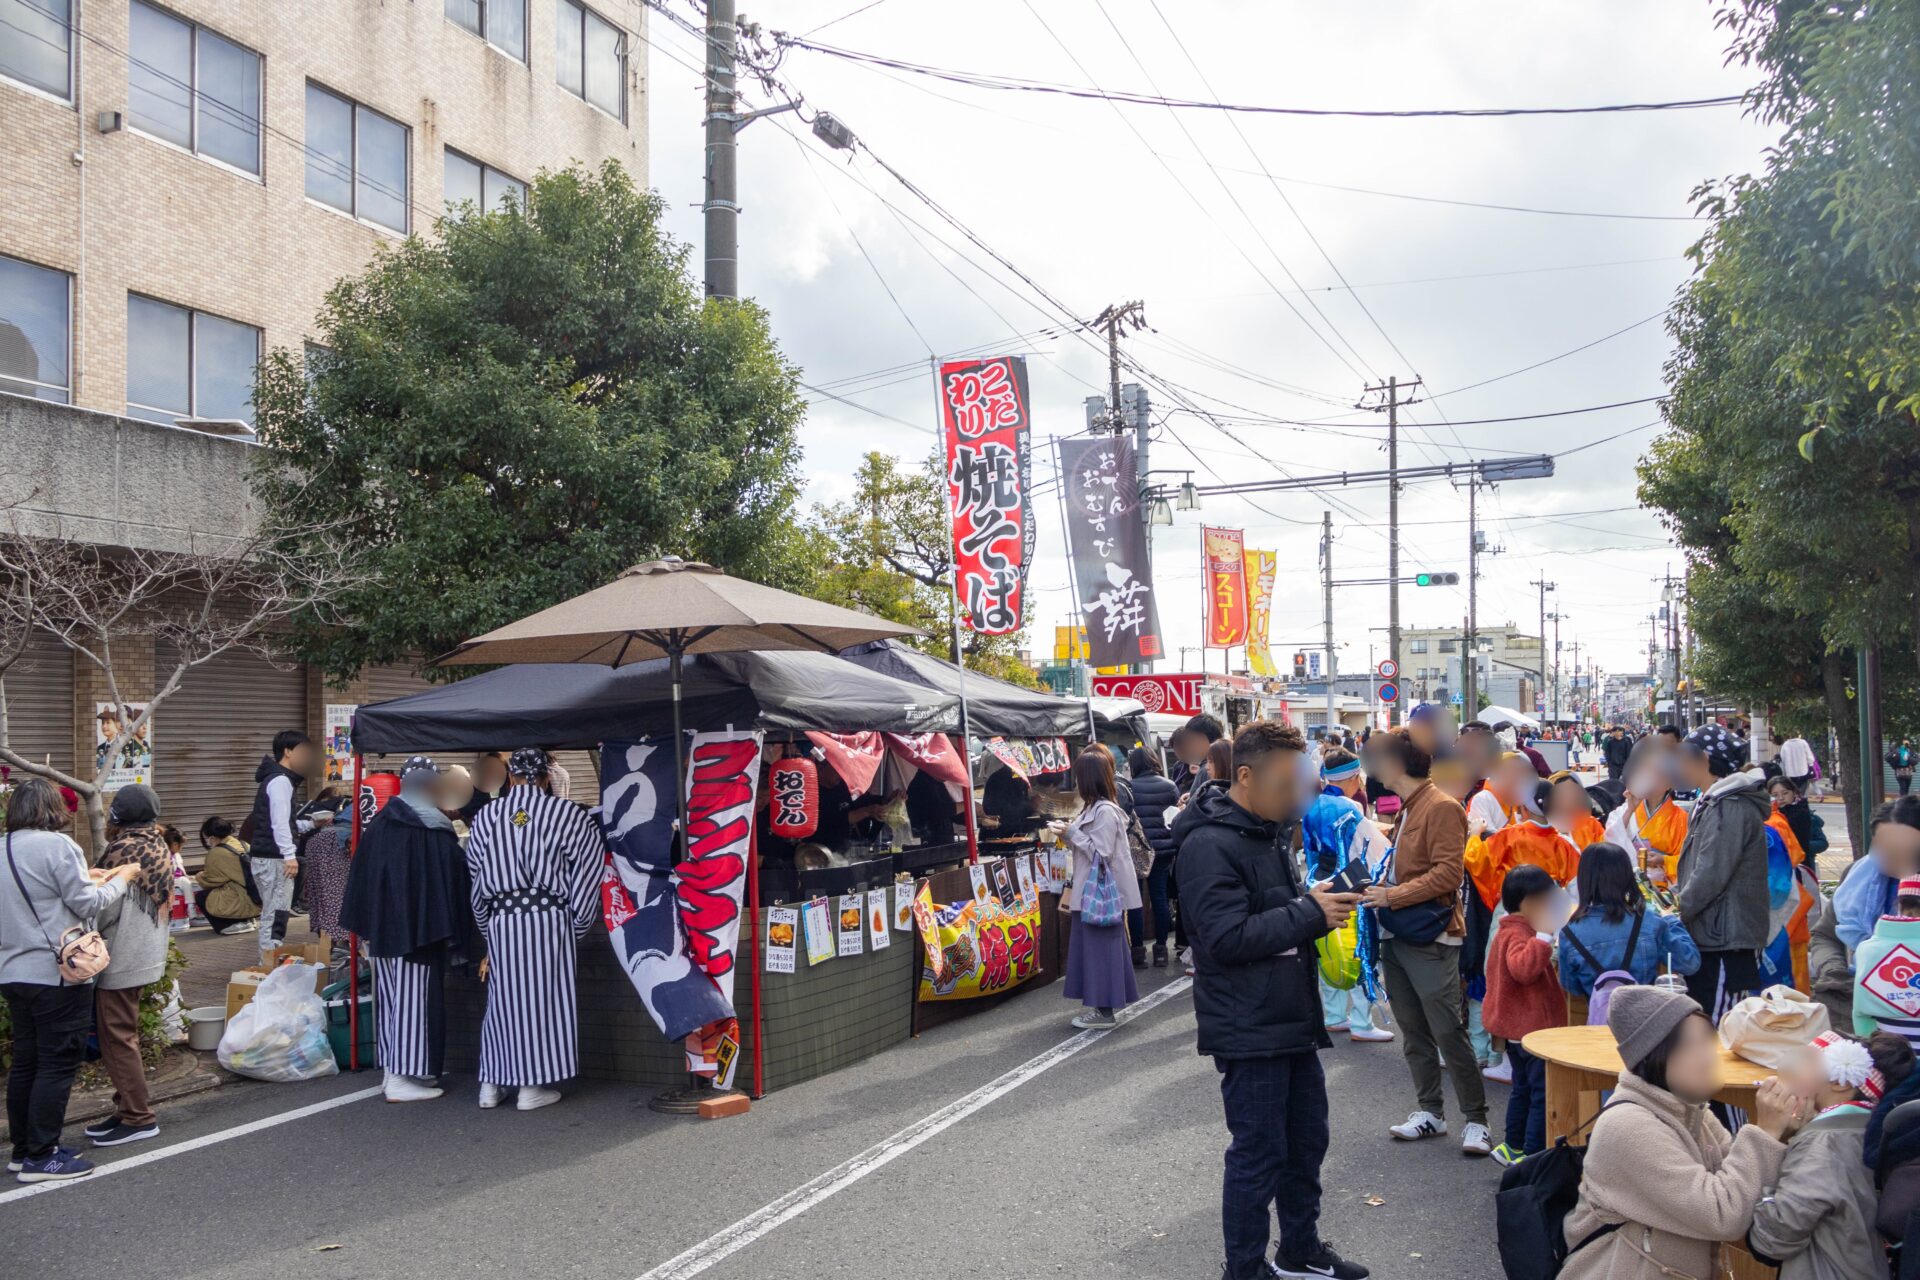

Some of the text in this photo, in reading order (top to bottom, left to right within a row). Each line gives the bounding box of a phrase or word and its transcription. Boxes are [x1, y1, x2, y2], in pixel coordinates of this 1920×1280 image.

[1082, 468, 1115, 557] おむすび
[1098, 452, 1127, 514] おでん
[949, 441, 1022, 633] 焼そば
[1215, 573, 1235, 643] スコーン
[1382, 665, 1394, 674] 40
[773, 769, 808, 826] おでん
